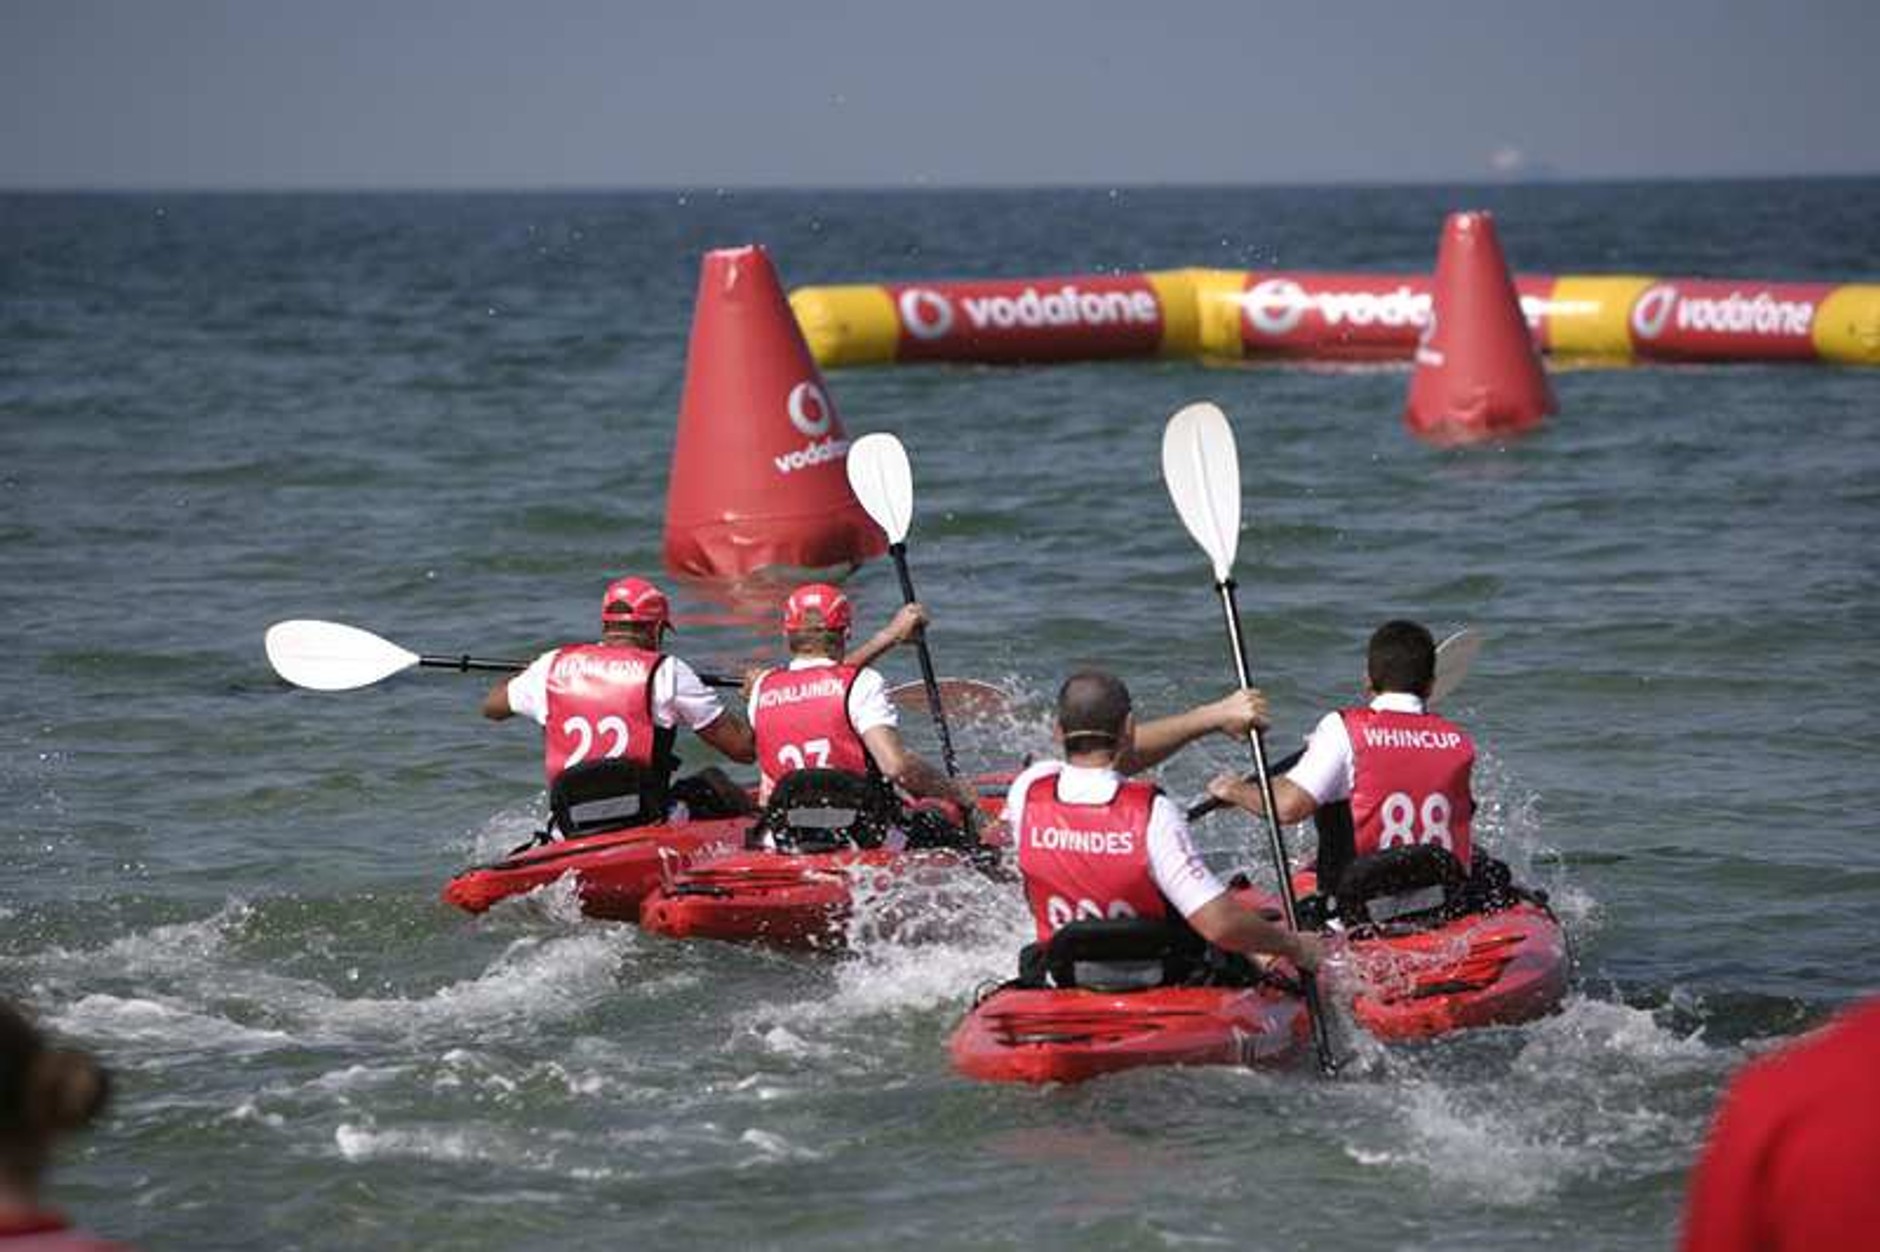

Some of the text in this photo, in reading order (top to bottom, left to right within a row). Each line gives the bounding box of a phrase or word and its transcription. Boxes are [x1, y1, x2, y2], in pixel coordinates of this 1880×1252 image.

[963, 286, 1156, 328] vodafone
[1678, 291, 1814, 335] vodafone
[563, 716, 629, 770] 22
[1363, 727, 1461, 749] WHINCUP
[1031, 827, 1134, 854] LOWNDES
[1379, 792, 1453, 851] 88
